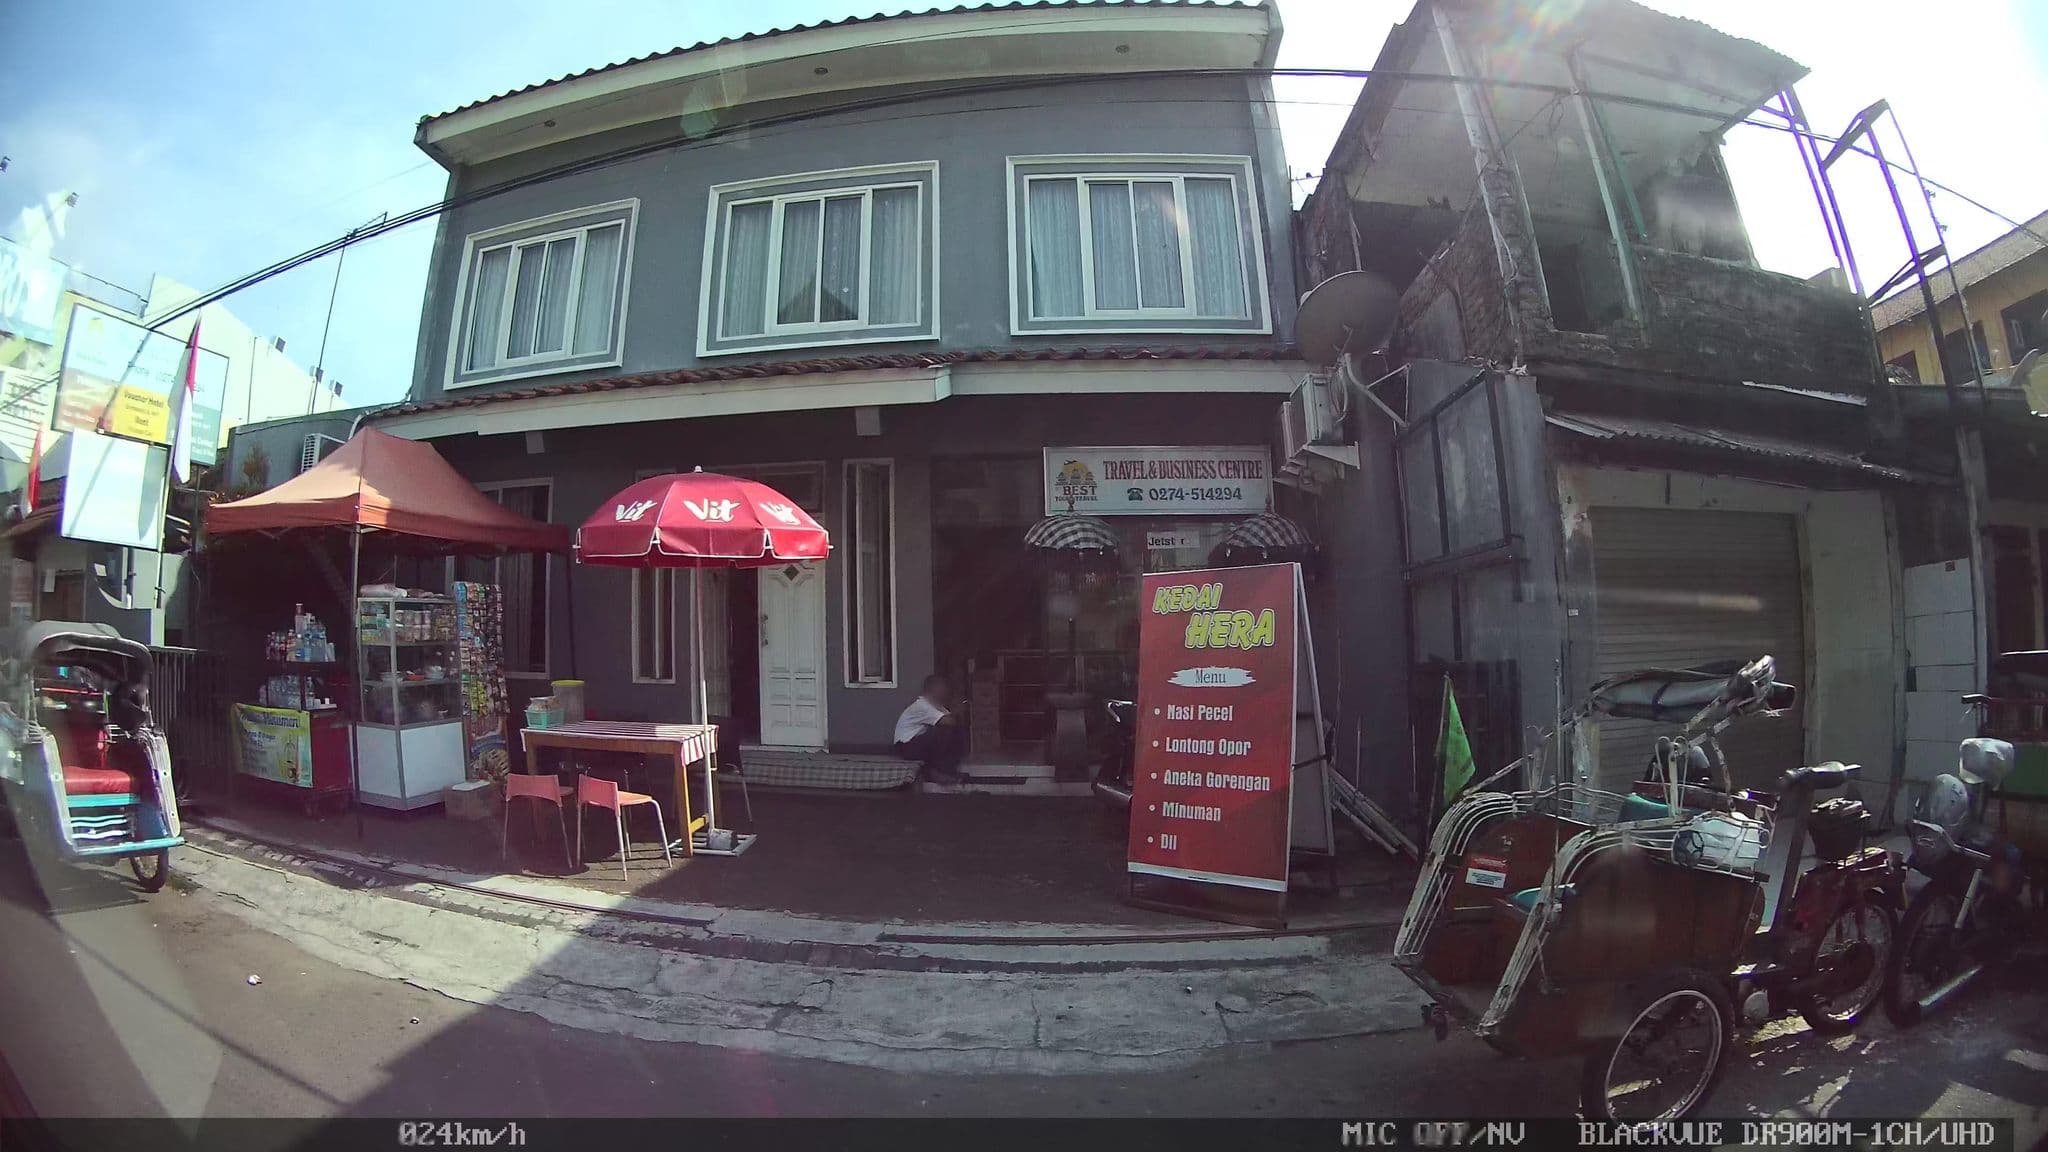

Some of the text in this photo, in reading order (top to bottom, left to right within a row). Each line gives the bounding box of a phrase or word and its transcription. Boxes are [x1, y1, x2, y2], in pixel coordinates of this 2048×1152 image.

[1103, 460, 1148, 480] TRAVEL
[1158, 460, 1216, 480] BUSINESS
[1218, 460, 1262, 480] CENTRE
[1063, 485, 1097, 495] BEST
[1149, 487, 1242, 501] 0274-514294
[615, 499, 657, 522] Vit
[683, 498, 740, 522] Vit
[1152, 583, 1223, 614] KEDAI
[1185, 608, 1275, 650] HERA
[1195, 670, 1226, 684] Menu
[1167, 705, 1233, 721] Nasi Pecel
[1165, 737, 1251, 757] Lontong Opor
[1163, 769, 1270, 792] Aneka Gorengan
[1162, 801, 1221, 822] Minuman
